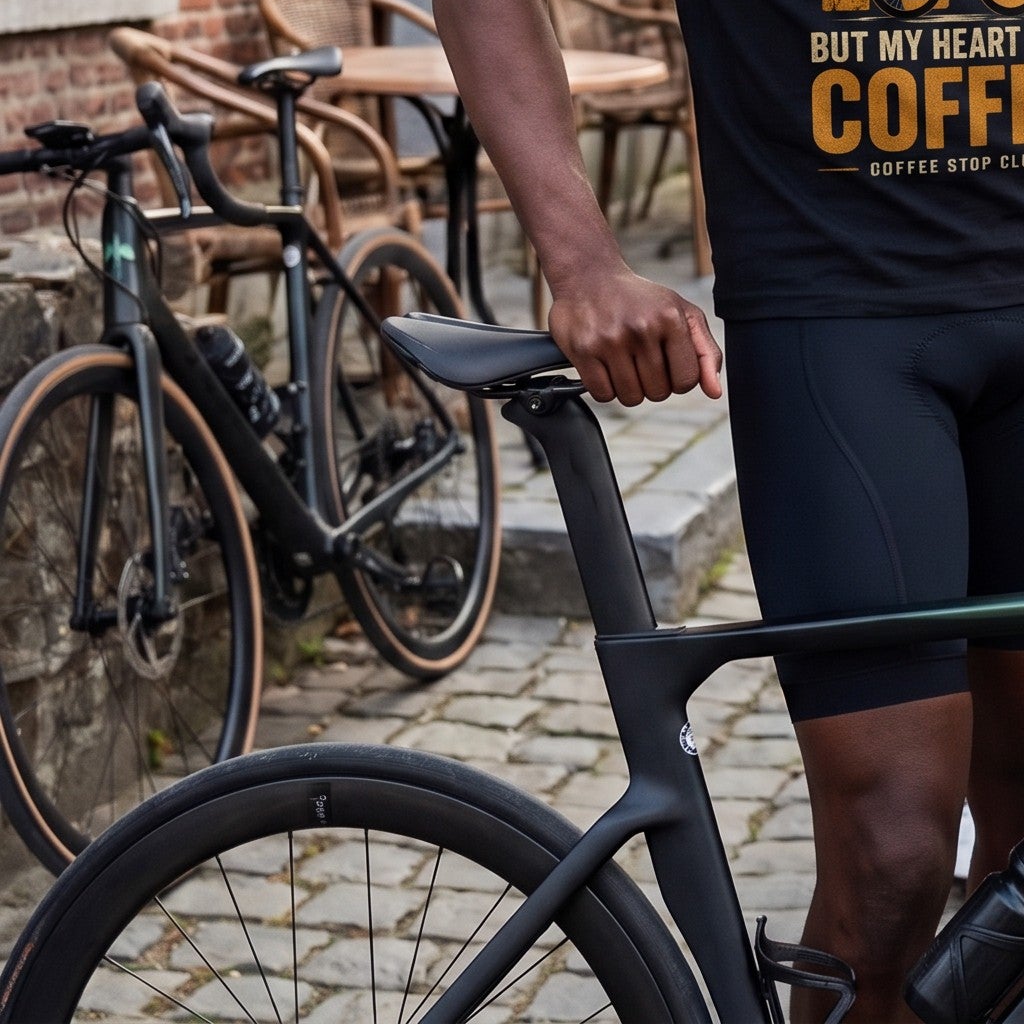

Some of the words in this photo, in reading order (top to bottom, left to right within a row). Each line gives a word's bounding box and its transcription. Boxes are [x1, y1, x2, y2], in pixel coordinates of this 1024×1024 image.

[810, 30, 869, 63] BUT
[879, 29, 923, 62] MY
[932, 25, 1021, 60] HEART
[870, 160, 940, 176] COFFEE
[947, 156, 992, 173] STOP
